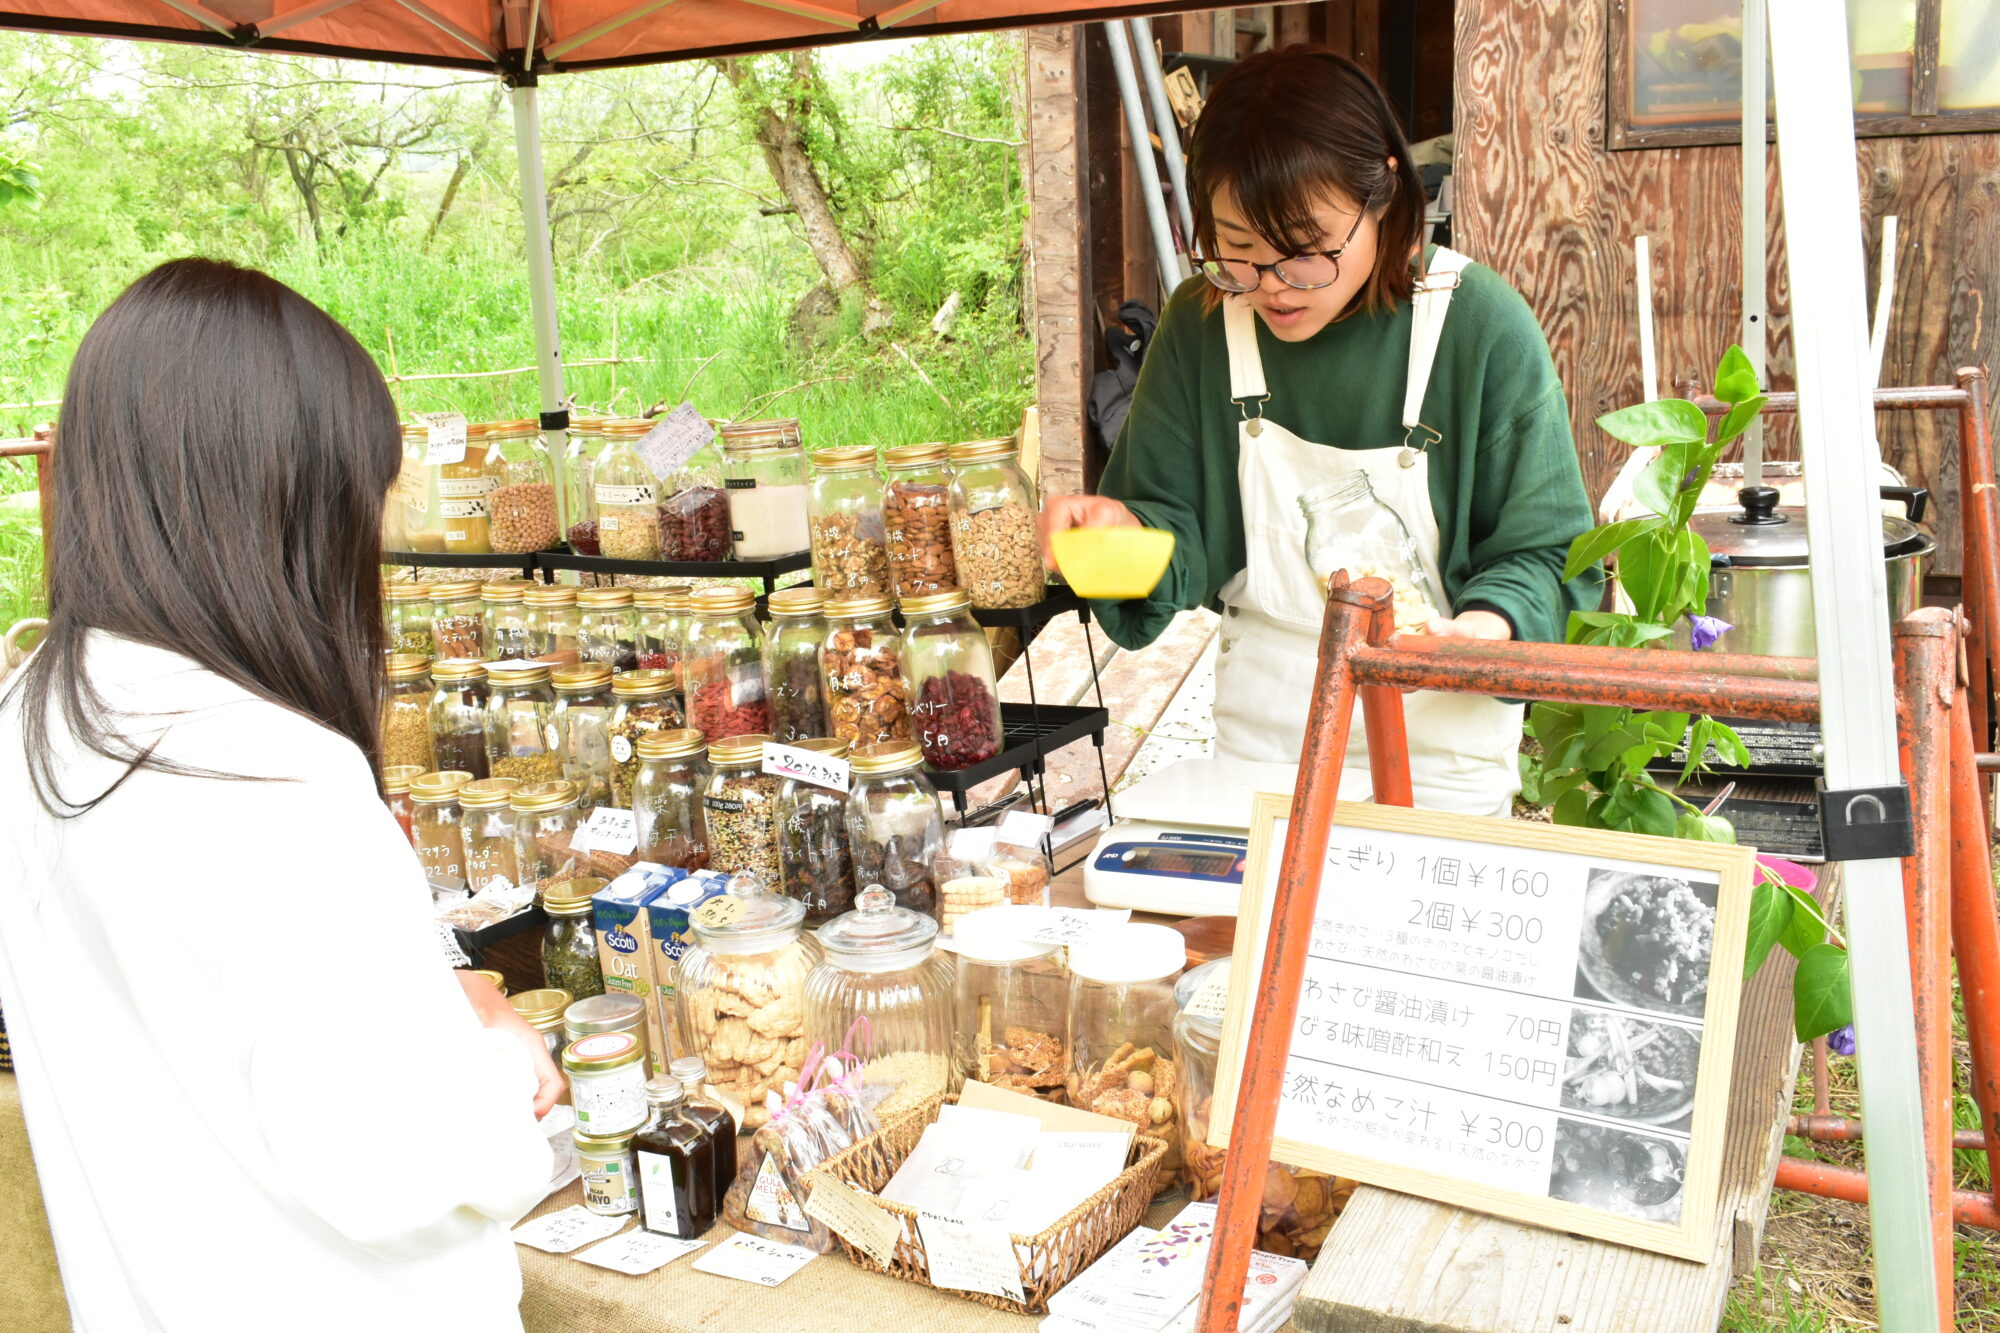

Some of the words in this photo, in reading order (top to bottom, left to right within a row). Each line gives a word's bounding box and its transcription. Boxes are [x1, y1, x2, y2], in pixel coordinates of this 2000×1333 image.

[923, 729, 949, 748] 5円
[608, 934, 636, 951] Scotti
[611, 956, 639, 979] Oat
[606, 975, 622, 988] Gluten
[621, 979, 633, 990] Free
[1504, 1012, 1562, 1047] 70円
[1482, 1050, 1558, 1088] 150円
[1058, 1141, 1077, 1149] chai
[587, 1191, 611, 1206] MAYO
[1278, 1256, 1297, 1264] Tree
